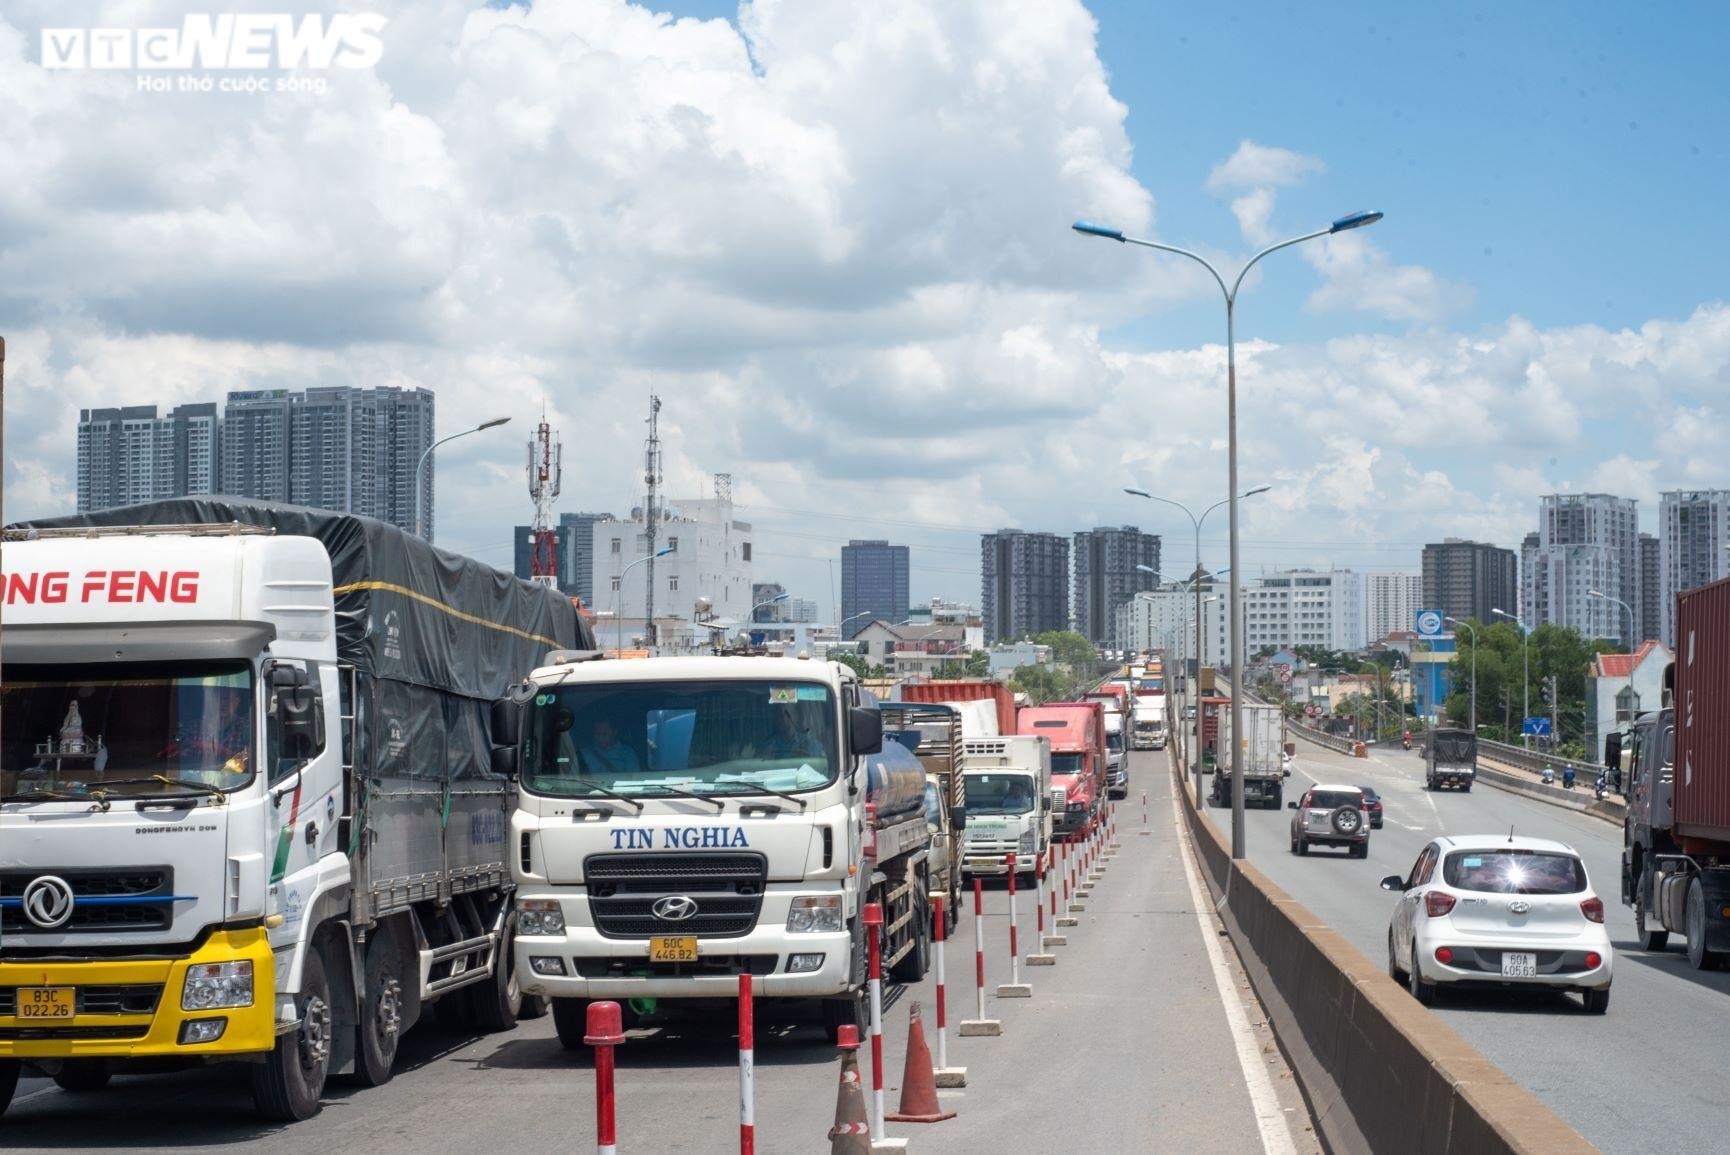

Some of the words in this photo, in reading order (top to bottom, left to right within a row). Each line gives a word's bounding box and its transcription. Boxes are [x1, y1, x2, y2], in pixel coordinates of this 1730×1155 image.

[81, 571, 199, 603] FENG
[610, 828, 654, 849] TIN
[664, 827, 749, 848] NGHIA
[663, 938, 683, 948] 60C
[1510, 955, 1528, 965] 60A
[34, 990, 58, 1002] 83C
[24, 1004, 68, 1016] 022.26
